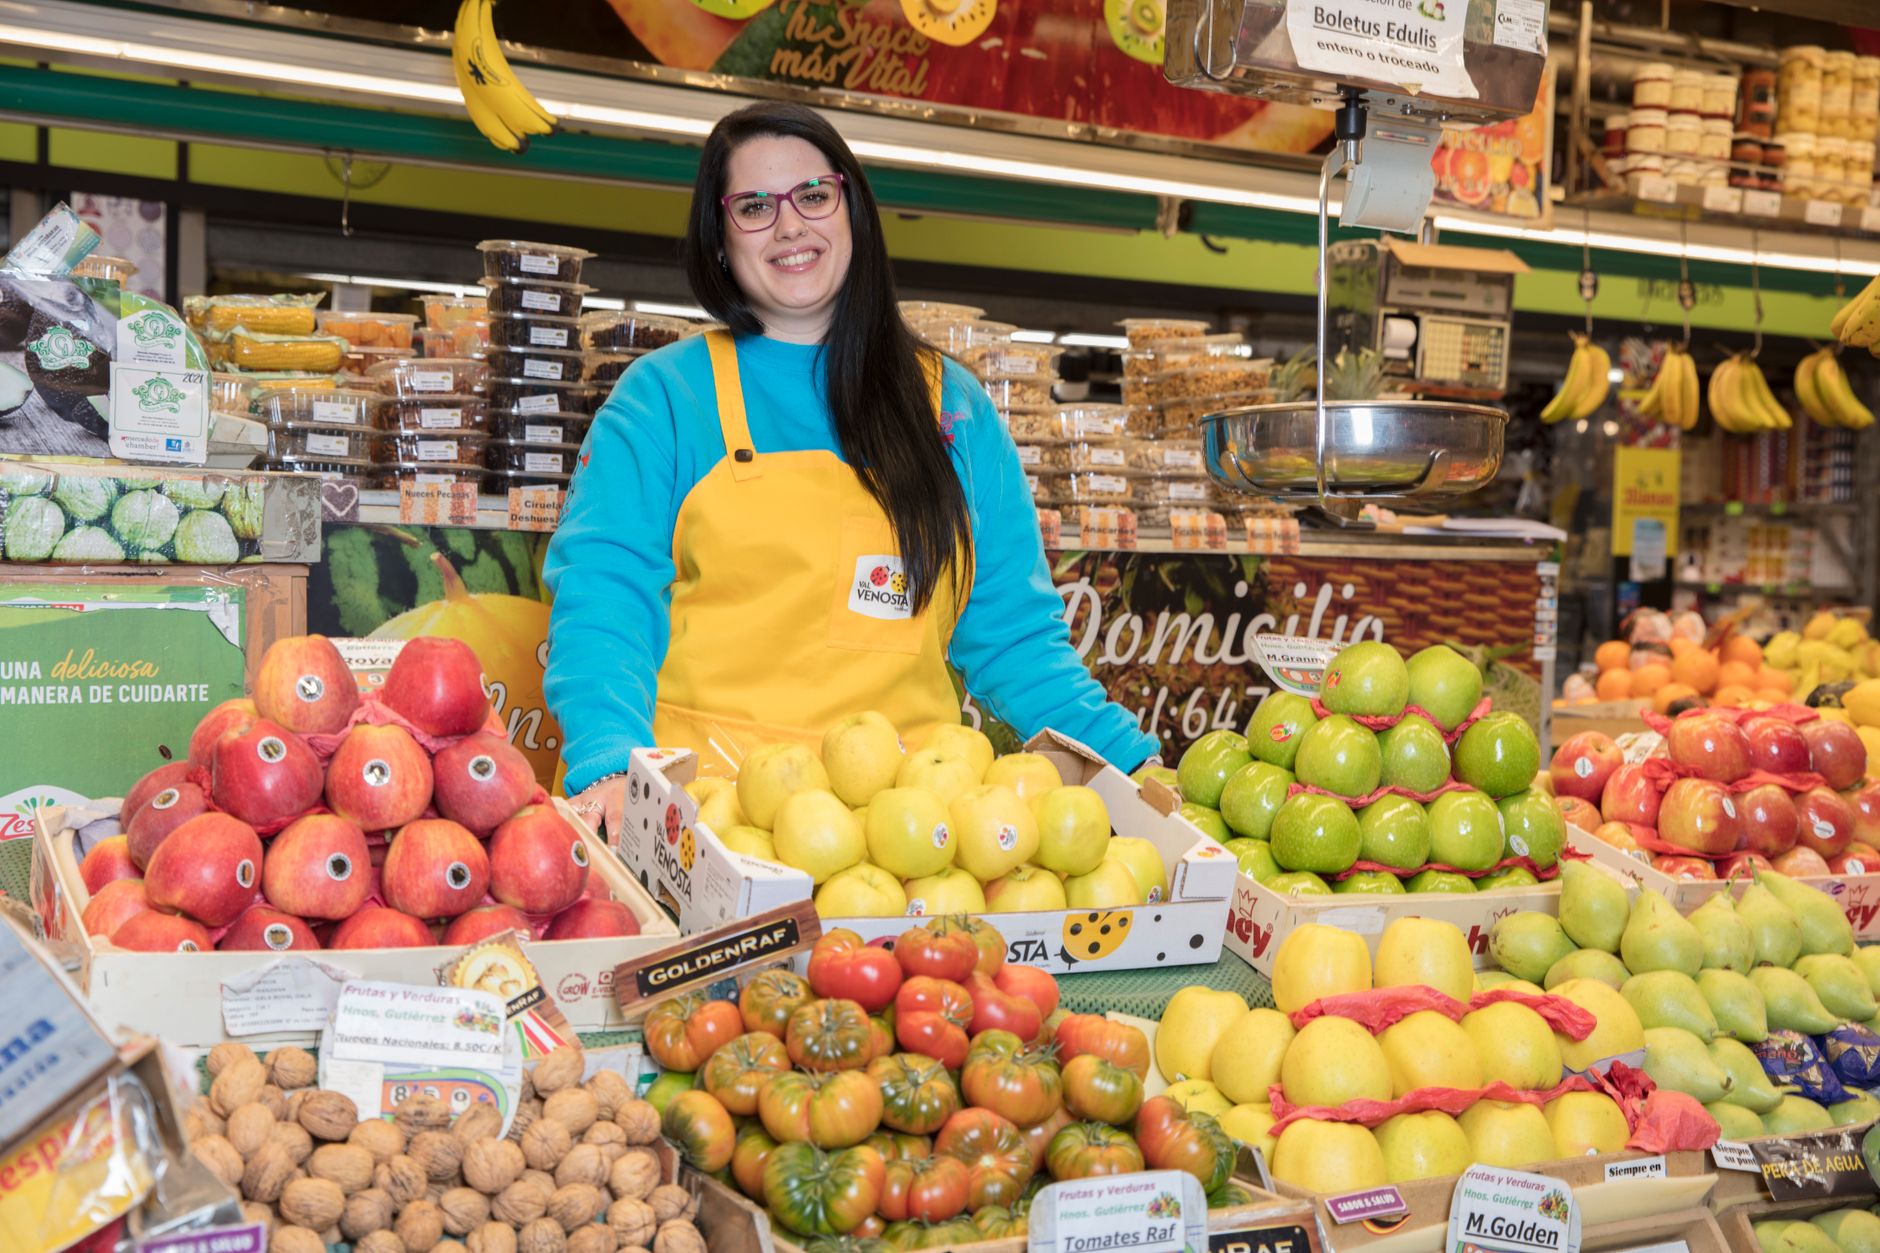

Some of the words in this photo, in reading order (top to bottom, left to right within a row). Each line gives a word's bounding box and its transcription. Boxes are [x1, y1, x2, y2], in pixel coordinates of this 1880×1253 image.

[824, 4, 930, 56] Snack
[1313, 6, 1381, 37] Boletus
[1386, 21, 1437, 49] Edulis
[1316, 40, 1363, 59] entero
[1366, 51, 1376, 60] o
[1379, 51, 1440, 74] troceado
[770, 44, 845, 83] más
[842, 48, 930, 96] Vital
[405, 490, 434, 498] Nueces
[437, 490, 470, 499] Pecanas
[524, 500, 561, 510] Ciruela
[510, 514, 559, 523] Deshues
[857, 589, 909, 607] VENOSTA
[1058, 576, 1384, 666] Domicilio
[0, 661, 42, 680] UNA
[51, 649, 160, 682] deliciosa
[0, 686, 83, 704] MANERA
[90, 685, 112, 703] DE
[119, 684, 209, 703] CUIDARTE
[0, 813, 34, 841] Zes
[653, 836, 692, 903] VENOSTA
[1004, 939, 1049, 963] STA
[343, 985, 387, 998] Frutas
[390, 989, 398, 1000] y
[402, 990, 460, 1005] Verduras
[384, 1008, 446, 1023] Gutiérrez
[1608, 1165, 1648, 1177] Siempre
[1649, 1163, 1662, 1173] en
[1736, 1156, 1757, 1167] punt
[1826, 1154, 1865, 1172] AGUA
[1466, 1171, 1495, 1183] Frutas
[1497, 1177, 1503, 1185] y
[1506, 1176, 1546, 1191] Verduras
[1058, 1190, 1094, 1201] Frutas
[1098, 1188, 1104, 1198] y
[1107, 1182, 1156, 1195] Verduras
[1371, 1194, 1396, 1207] SALUD
[1464, 1188, 1489, 1201] Hnos.
[1492, 1193, 1534, 1209] Gutiérrez
[1059, 1210, 1089, 1221] Hnos.
[1094, 1203, 1145, 1217] Gutiérrez
[1064, 1231, 1141, 1251] Tomates
[1146, 1223, 1177, 1241] Raf
[1465, 1212, 1559, 1246] M.Golden
